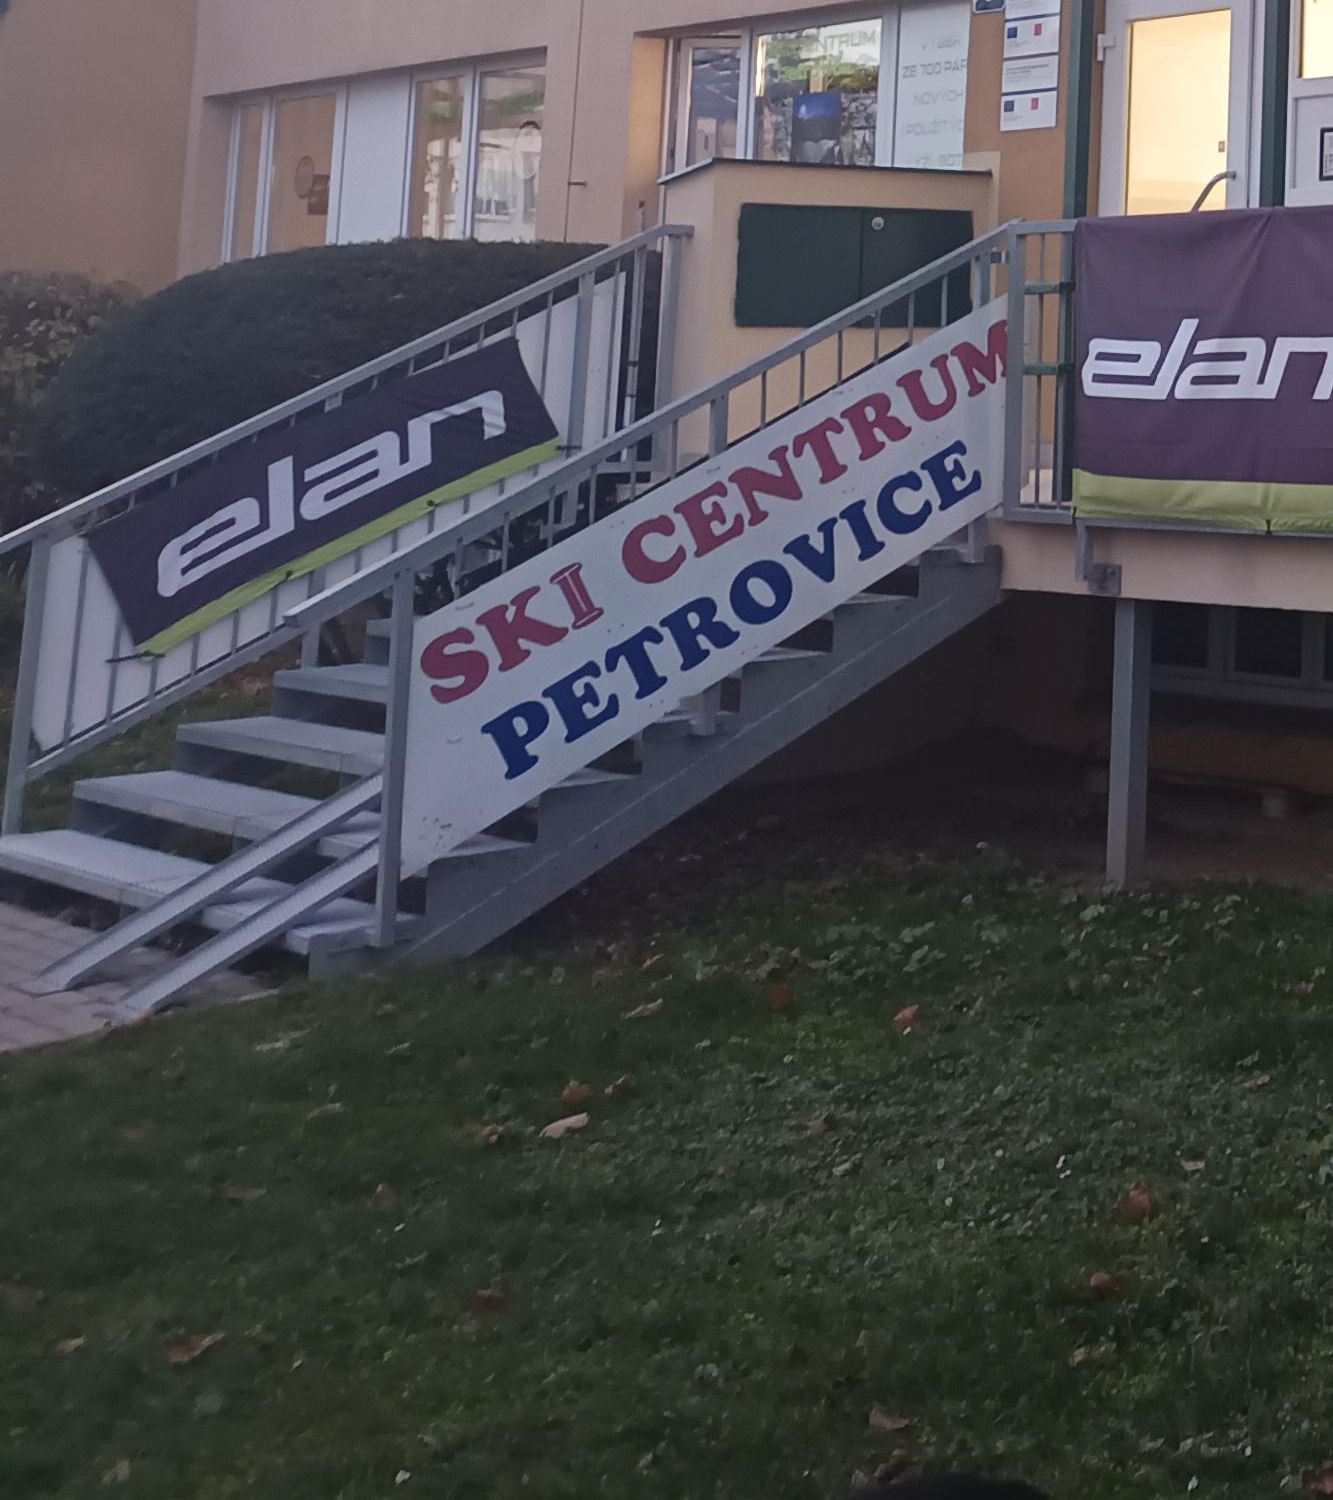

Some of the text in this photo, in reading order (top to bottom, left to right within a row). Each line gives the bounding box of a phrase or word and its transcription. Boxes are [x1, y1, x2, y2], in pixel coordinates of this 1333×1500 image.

[156, 389, 507, 599] elan
[419, 318, 1007, 705] SKI CENTRUM
[480, 440, 982, 781] PETROVICE
